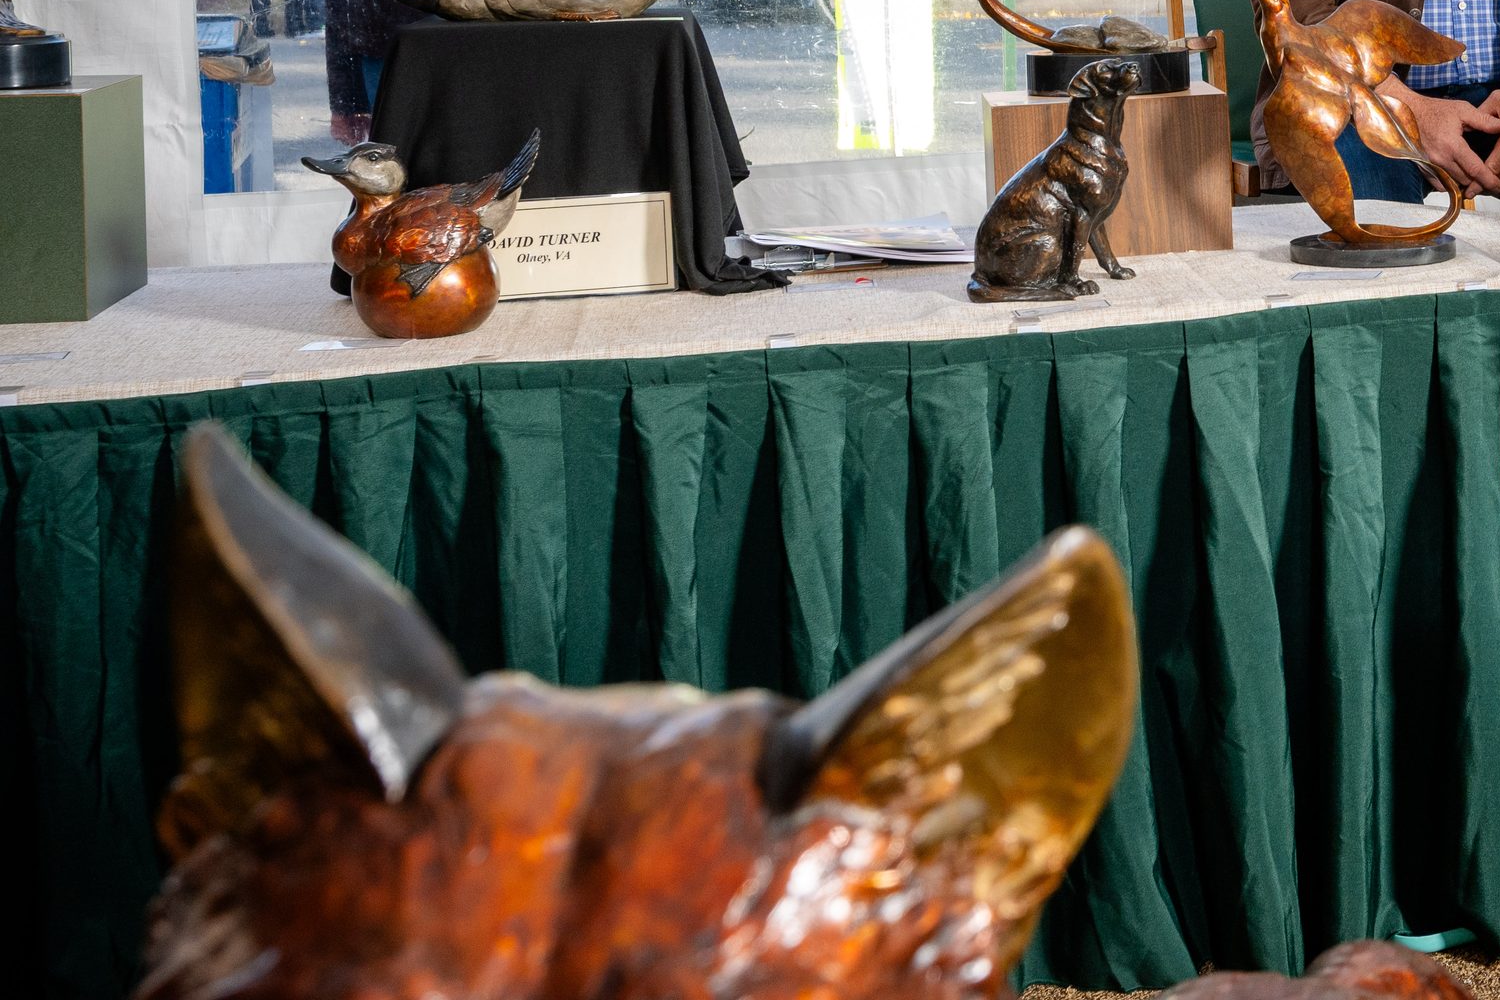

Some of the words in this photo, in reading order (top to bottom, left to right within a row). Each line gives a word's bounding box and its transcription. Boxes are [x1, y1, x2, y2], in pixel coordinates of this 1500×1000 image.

[539, 231, 601, 247] TURNER
[517, 252, 551, 264] Olney,
[556, 251, 571, 261] VA
